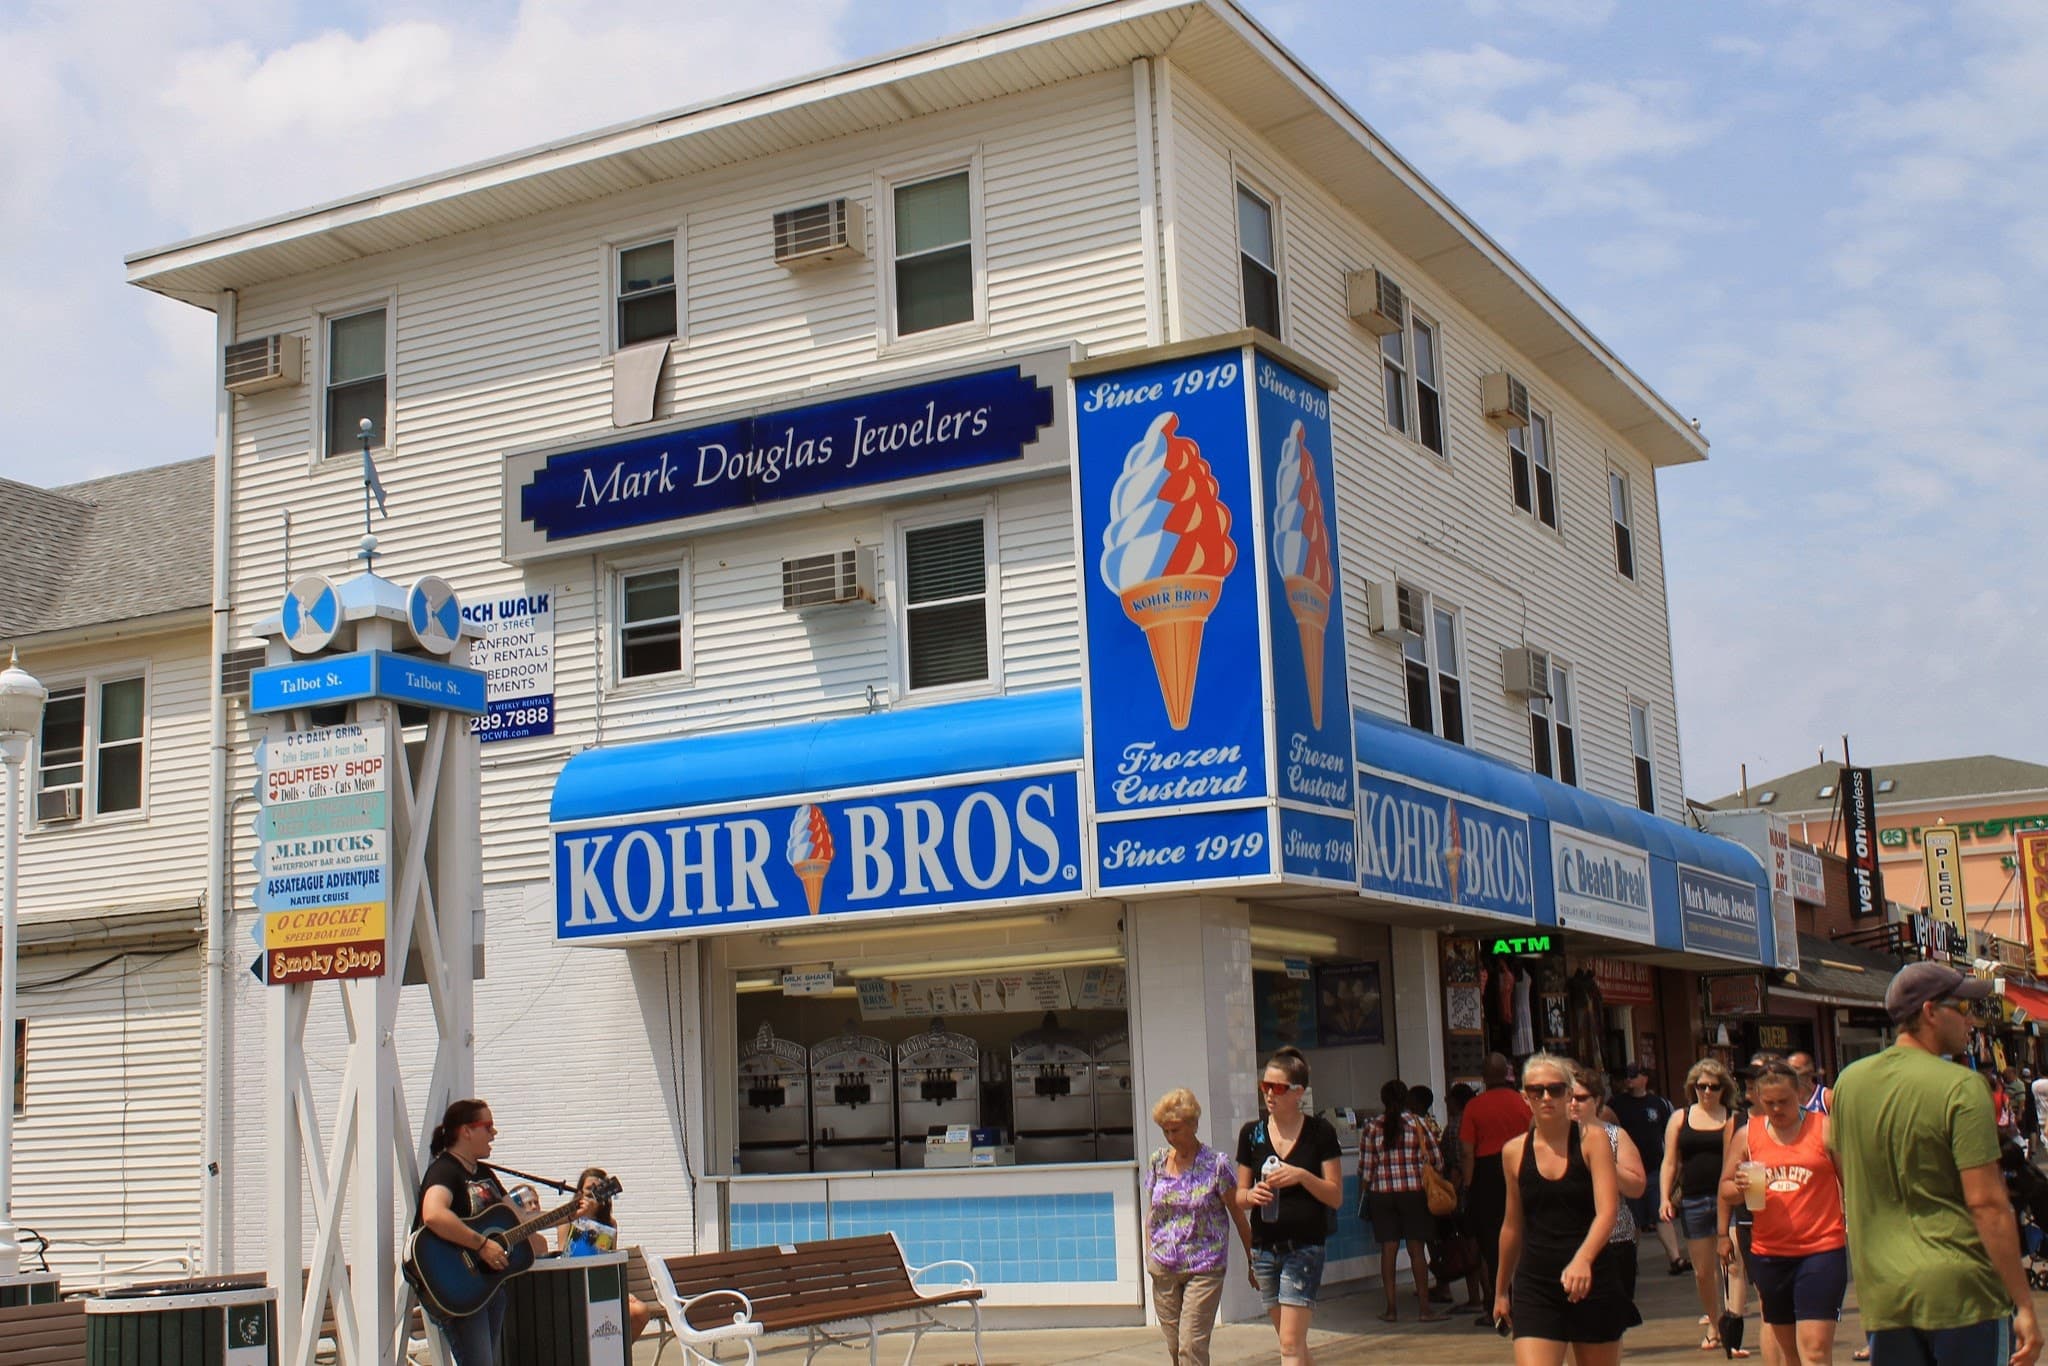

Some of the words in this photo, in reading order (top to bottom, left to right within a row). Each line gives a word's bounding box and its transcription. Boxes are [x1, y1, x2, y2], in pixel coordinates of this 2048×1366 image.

[1083, 382, 1164, 413] Since
[1172, 362, 1237, 399] 1919
[1258, 364, 1297, 405] Since
[1299, 390, 1327, 421] 1919
[575, 455, 677, 509] Mark
[694, 429, 833, 488] Douglas
[462, 603, 493, 623] ACH
[500, 594, 549, 618] WALK
[1132, 592, 1171, 612] KOHR
[1175, 589, 1209, 602] BROS
[503, 617, 536, 632] STREET
[470, 632, 536, 652] EANFRONT
[494, 645, 549, 663] RENTALS
[281, 676, 321, 694] Talbot
[326, 672, 342, 686] St.
[406, 671, 442, 692] Talbot
[446, 682, 461, 696] St.
[488, 662, 548, 681] BEDROOM
[488, 678, 536, 695] TMENTS
[470, 706, 548, 732] 289.7888
[288, 736, 294, 746] O
[297, 735, 303, 745] C
[306, 730, 331, 744] DAILY
[335, 726, 362, 739] GRIND
[481, 729, 529, 741] OCWR.com
[1117, 740, 1242, 776] Frozen
[1289, 732, 1345, 773] Frozen
[269, 764, 338, 787] COURTESY
[345, 758, 382, 777] SHOP
[1287, 766, 1347, 803] Custard
[281, 787, 299, 801] Dolls
[308, 782, 327, 798] Gifts
[335, 780, 351, 794] Cats
[354, 778, 376, 791] Meow
[1112, 766, 1248, 805] Custard
[275, 833, 374, 859] M.R.DUCKS
[1103, 839, 1186, 869] Since
[1195, 831, 1263, 862] 1919
[1284, 828, 1322, 860] Since
[1325, 839, 1352, 865] 1919
[1359, 788, 1443, 889] KOHR
[1769, 827, 1788, 850] NAME
[272, 860, 318, 872] WATERFRONT
[320, 857, 335, 866] BAR
[336, 856, 351, 865] AND
[354, 853, 379, 863] GRILLE
[563, 818, 779, 929] KOHR
[1775, 851, 1784, 871] OF
[268, 874, 324, 895] ASSATEAGUE
[327, 869, 380, 888] ADVENTURE
[1575, 848, 1614, 900] Beach
[1614, 858, 1647, 908] Break
[290, 894, 320, 906] NATURE
[322, 891, 350, 903] CRUISE
[1684, 881, 1703, 911] Mark
[1703, 887, 1730, 918] Douglas
[1730, 895, 1756, 923] Jewelers
[277, 914, 289, 930] O
[292, 913, 304, 929] C
[305, 907, 372, 927] ROCKET
[283, 931, 313, 943] SPEED
[313, 928, 339, 941] BOAT
[339, 926, 363, 938] RIDE
[1913, 912, 1947, 951] verizon
[1493, 936, 1550, 955] ATM
[273, 950, 334, 979] Smoky
[334, 946, 382, 973] Shop
[784, 975, 802, 984] MILK
[804, 972, 832, 981] SHAKE
[1789, 1166, 1813, 1184] CITY
